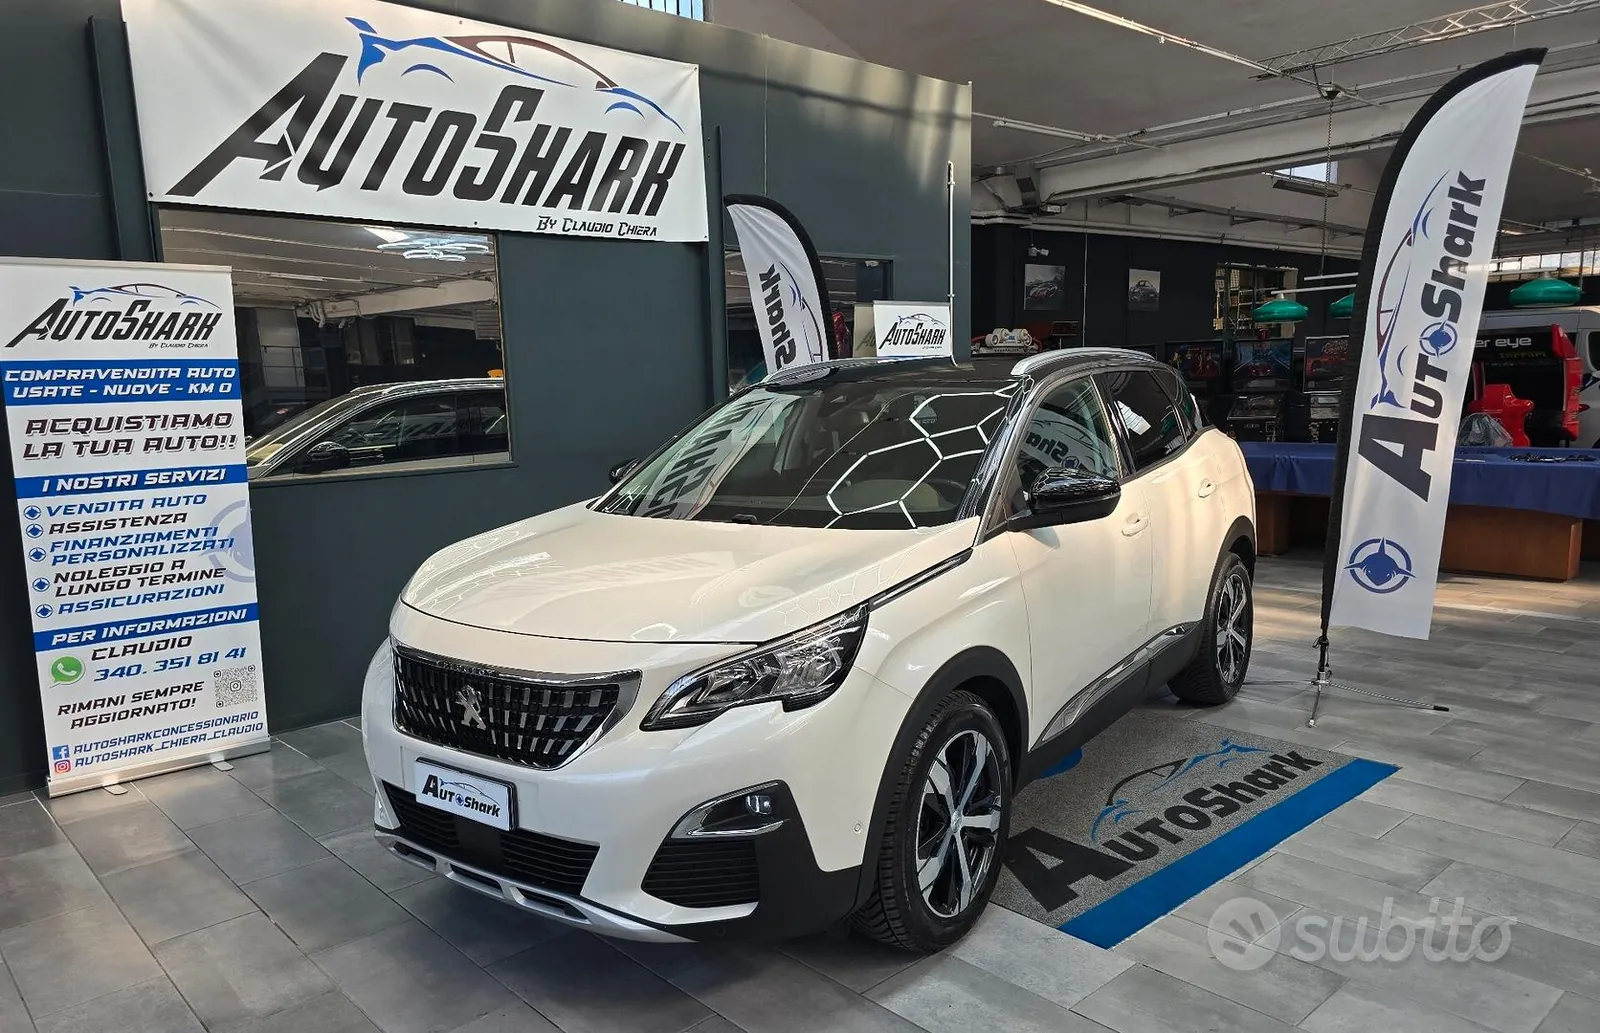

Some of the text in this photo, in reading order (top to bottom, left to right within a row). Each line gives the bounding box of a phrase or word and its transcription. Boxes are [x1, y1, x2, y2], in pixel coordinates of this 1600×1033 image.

[1495, 337, 1532, 349] eye
[4, 367, 237, 382] COMPRAVENDITA AUTO
[13, 385, 83, 398] USATE
[102, 383, 171, 396] NUOVE
[188, 383, 214, 394] KM
[25, 412, 234, 437] ACQUISTIAMO
[23, 434, 238, 460] LA TUA AUTO!!
[41, 468, 227, 493] I NOSTRI SERVIZI
[46, 494, 207, 518] VENDITA AUTO
[49, 512, 188, 535] ASSISTENZA
[50, 526, 219, 553] FINANZIAMENTI
[51, 538, 235, 566] PERSONALIZZATI
[53, 560, 186, 584] NOLEGGIO A
[54, 567, 227, 598] LUNGO TERMINE
[58, 584, 225, 615] ASSICURAZIONI
[51, 608, 248, 647] PER INFORMAZIONI
[91, 636, 193, 661] CLAUDIO
[152, 656, 191, 673] 351
[197, 651, 219, 665] 81
[225, 647, 247, 660] 41
[57, 681, 205, 716] RIMANI SEMPRE
[70, 698, 197, 730] AGGIORNATO!
[73, 711, 259, 755] AUTOSHARKCONCESSIONARIO
